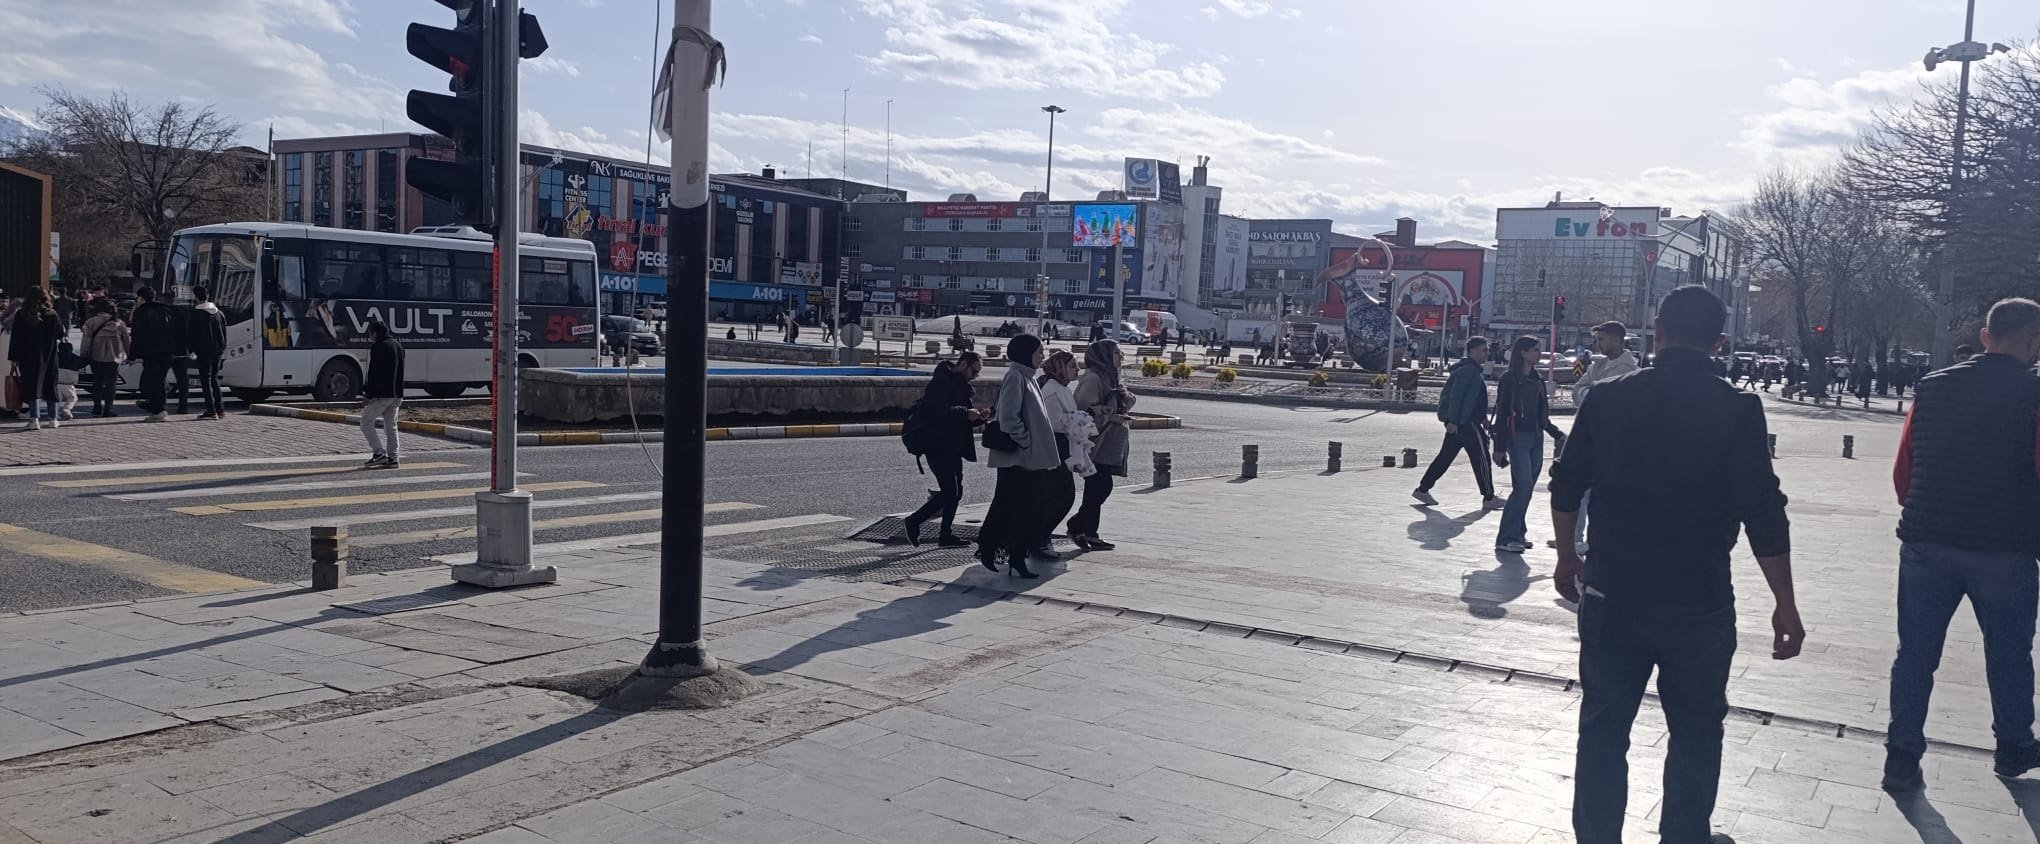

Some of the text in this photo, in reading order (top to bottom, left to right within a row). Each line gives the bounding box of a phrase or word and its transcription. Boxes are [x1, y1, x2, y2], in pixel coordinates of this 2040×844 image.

[590, 160, 611, 176] NK
[564, 188, 588, 197] FITNSS
[1554, 217, 1590, 237] Ev
[637, 250, 669, 269] PEGE
[1072, 299, 1106, 309] gelinlik
[345, 306, 453, 335] VAULT
